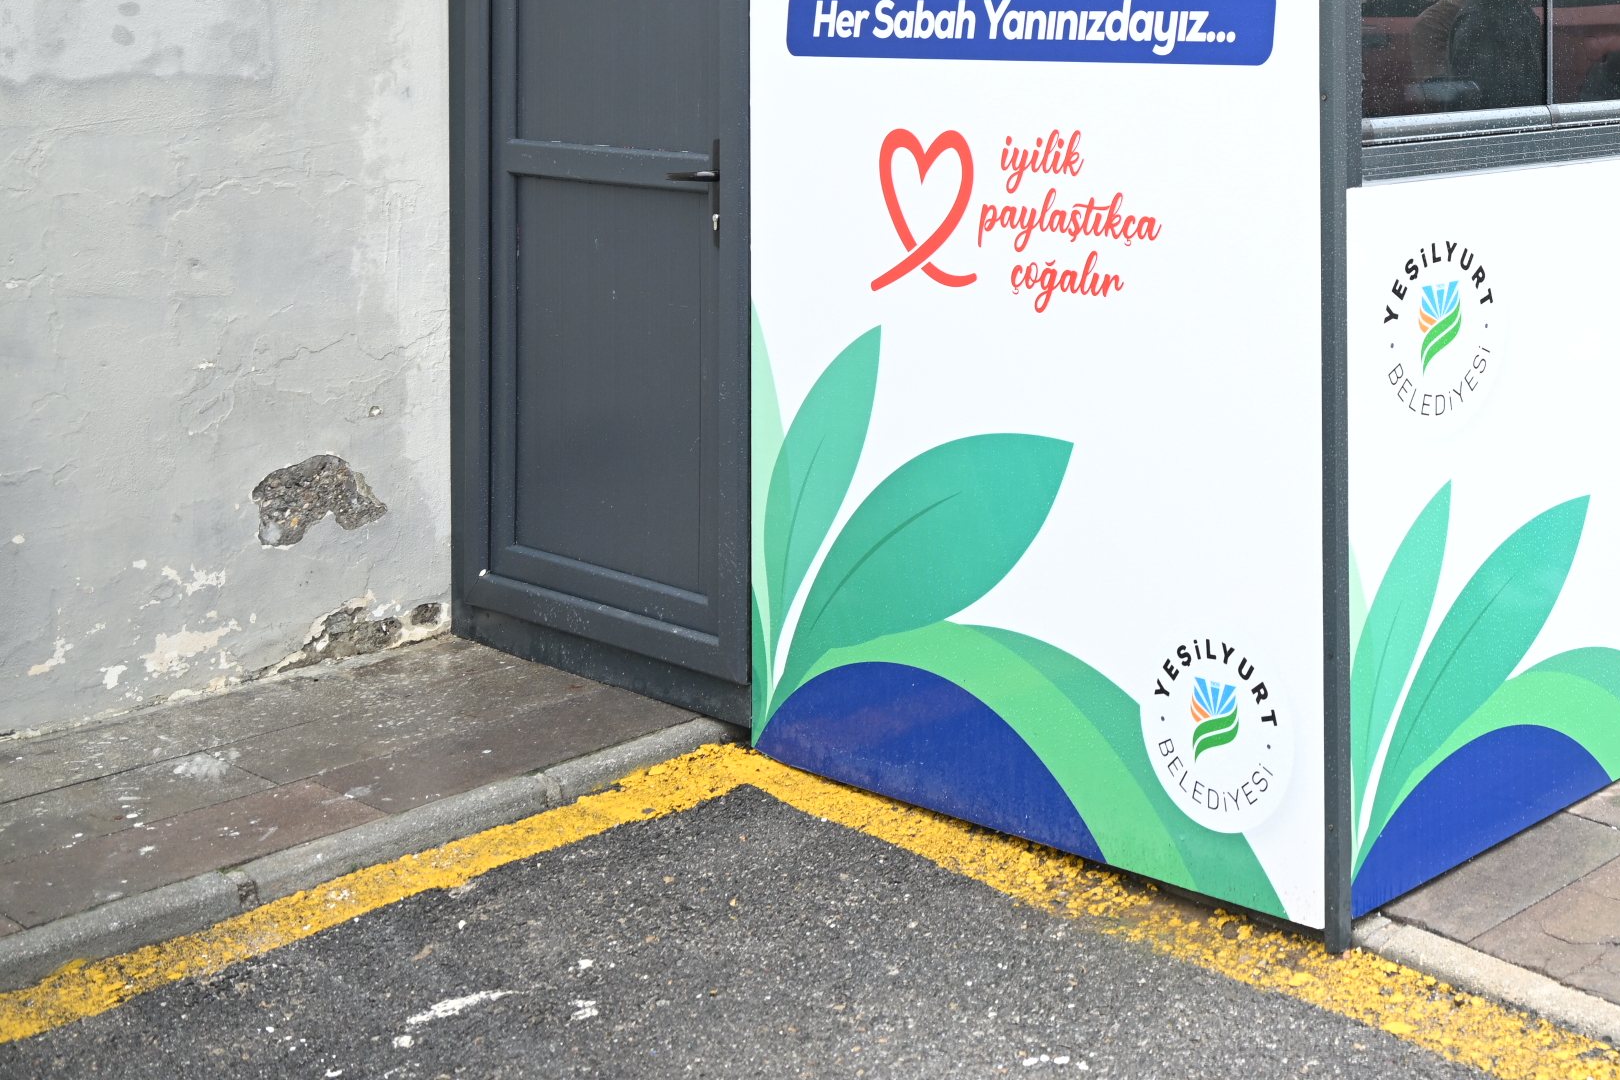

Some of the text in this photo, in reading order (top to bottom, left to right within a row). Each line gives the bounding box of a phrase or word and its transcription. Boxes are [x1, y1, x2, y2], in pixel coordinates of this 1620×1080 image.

[813, 0, 1235, 55] Her Sabah Yanınızdayız...
[1001, 129, 1084, 194] iyilik
[978, 188, 1162, 252] paylaştıkça
[1011, 251, 1124, 313] çoğalır
